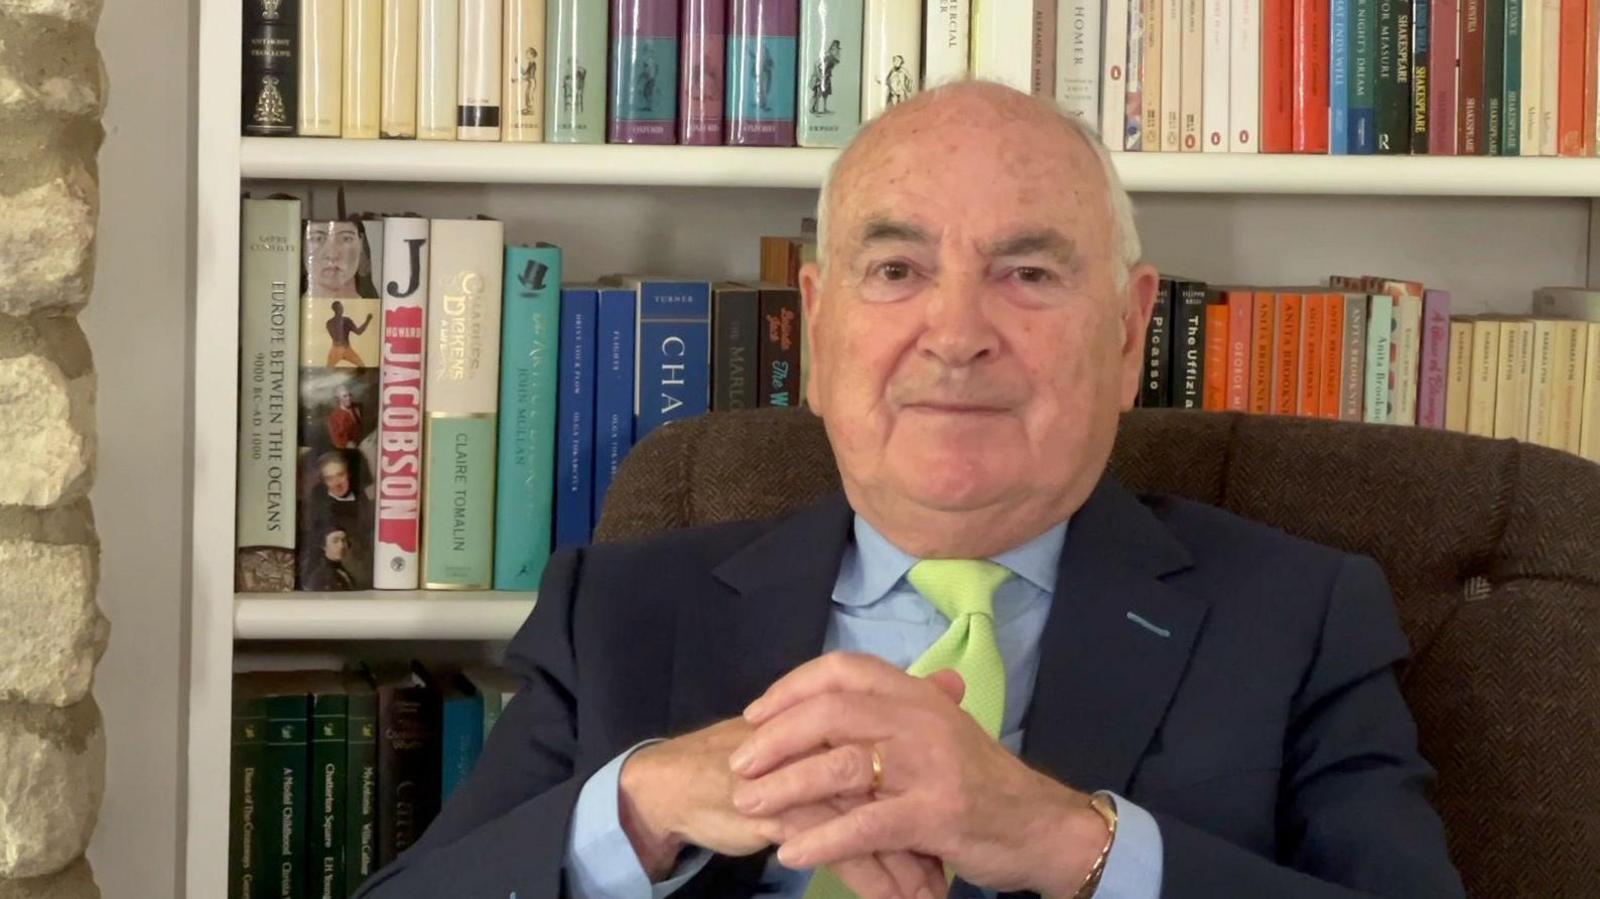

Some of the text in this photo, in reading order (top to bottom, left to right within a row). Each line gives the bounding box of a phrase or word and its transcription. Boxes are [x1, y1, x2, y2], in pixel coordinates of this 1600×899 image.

[1073, 7, 1085, 66] HOMER
[1380, 25, 1390, 79] MEASURE
[1397, 14, 1409, 84] SHAKESPEARE
[1356, 57, 1367, 97] DREAM
[1415, 66, 1427, 133] SHAKESPEARE
[1466, 97, 1477, 153] SHAKESPEARE
[1489, 97, 1500, 155] SHAKESPEARE
[1507, 91, 1518, 149] SHAKESPEARE
[386, 238, 427, 299] J
[654, 295, 693, 303] TURNER
[385, 327, 423, 338] HOWARD
[444, 294, 467, 381] DICKENS
[1187, 315, 1200, 346] The
[1282, 303, 1295, 346] ANITA
[254, 353, 264, 383] 9000
[770, 360, 790, 389] The
[1150, 316, 1164, 391] Picasso
[1184, 349, 1199, 395] Uffizi
[1255, 303, 1270, 413] ANITA BROOKNER
[1347, 305, 1363, 416] ANITA BROOKNER
[1375, 335, 1388, 368] Anita
[660, 335, 686, 426] CHA
[266, 281, 287, 532] EUROPE BETWEEN THE OCEANS
[378, 343, 422, 520] JACOBSON
[514, 368, 529, 465] JOHN MULLAN
[571, 411, 581, 436] OLGA
[610, 414, 620, 438] OLGA
[251, 433, 262, 460] 1000
[454, 432, 469, 484] CLAIRE
[452, 489, 468, 551] TOMALIN
[244, 795, 254, 804] of
[282, 777, 294, 805] Model
[325, 763, 335, 813] Chatterton
[282, 807, 294, 856] Childhood
[322, 815, 335, 848] Square
[361, 823, 372, 845] Willa
[361, 845, 371, 876] Cather
